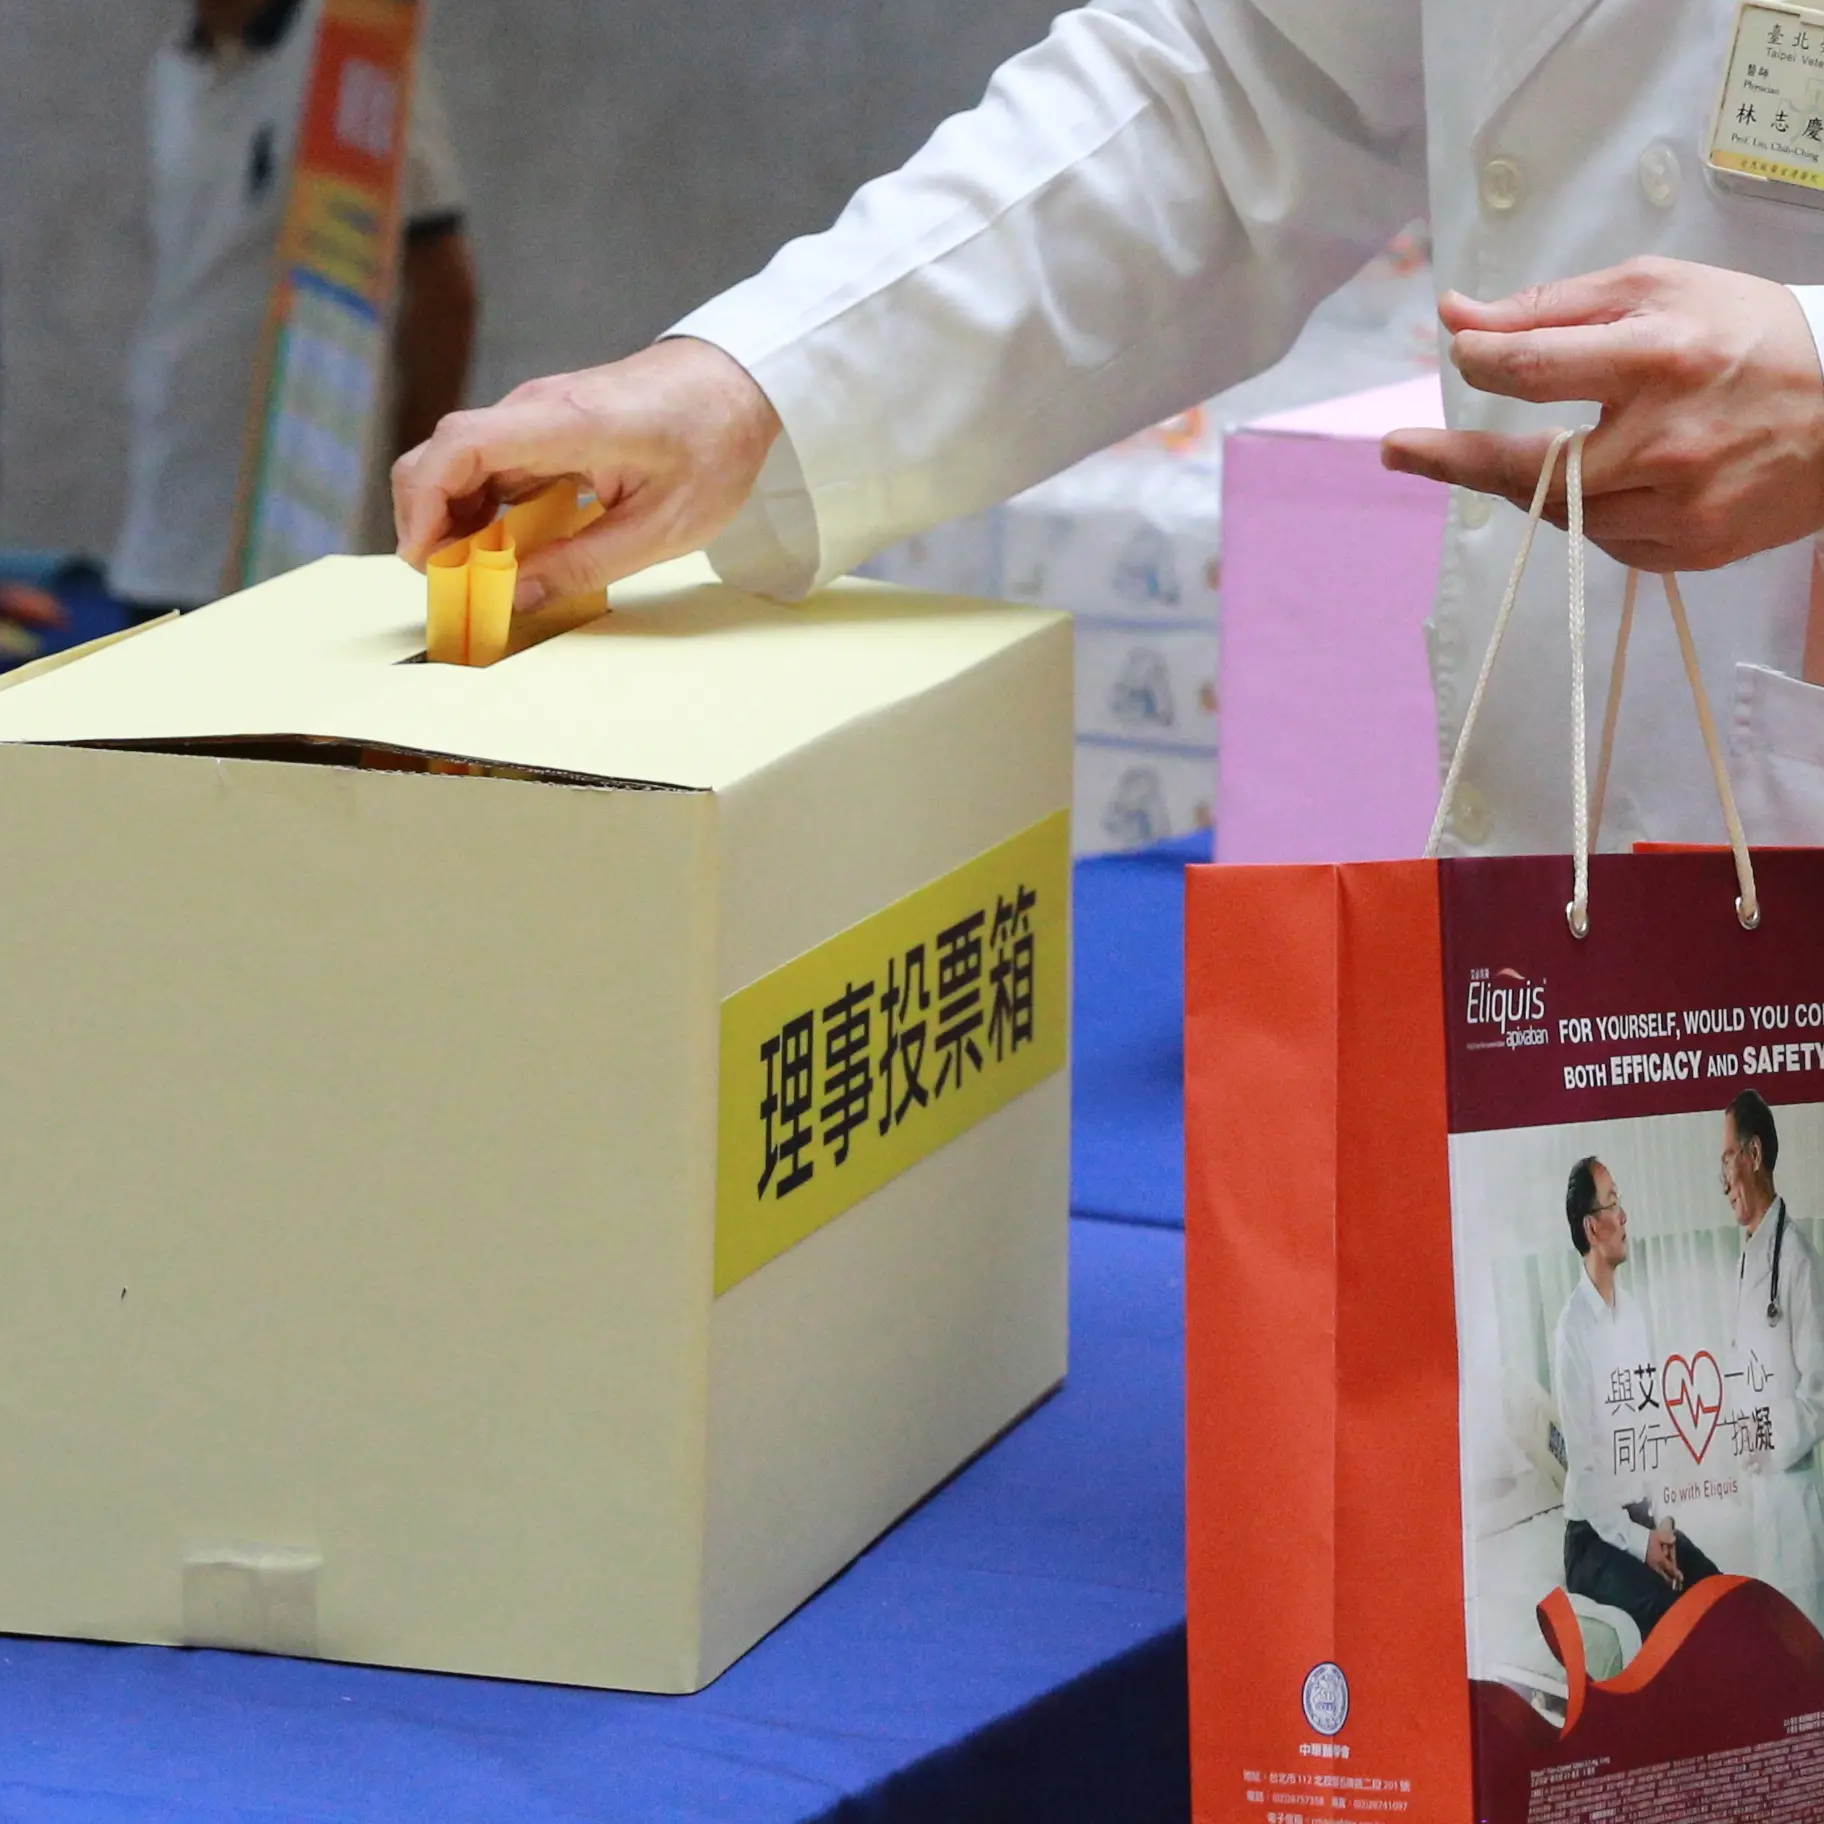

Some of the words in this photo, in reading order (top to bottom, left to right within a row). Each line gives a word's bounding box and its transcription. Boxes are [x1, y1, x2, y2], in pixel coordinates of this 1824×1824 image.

[1766, 48, 1797, 64] Taipei
[1736, 103, 1824, 142] 林志慶
[1467, 979, 1546, 1035] Eliquis
[1559, 1018, 1593, 1044] FOR
[1596, 1011, 1682, 1042] YOURSELF,
[1683, 1007, 1745, 1035] WOULD
[1749, 1004, 1789, 1031] YOU
[757, 884, 1037, 1202] 理事投票箱
[1506, 1025, 1549, 1051] apixaban
[1564, 1064, 1607, 1090] BOTH
[1610, 1050, 1703, 1086] EFFICACY
[1707, 1054, 1739, 1078] AND
[1605, 1363, 1660, 1416] 與艾
[1724, 1349, 1774, 1393] 一心
[1614, 1423, 1666, 1476] 同行
[1728, 1406, 1775, 1456] 抗凝
[1663, 1486, 1677, 1504] Go
[1679, 1482, 1701, 1501] with
[1704, 1477, 1739, 1501] Eliquis
